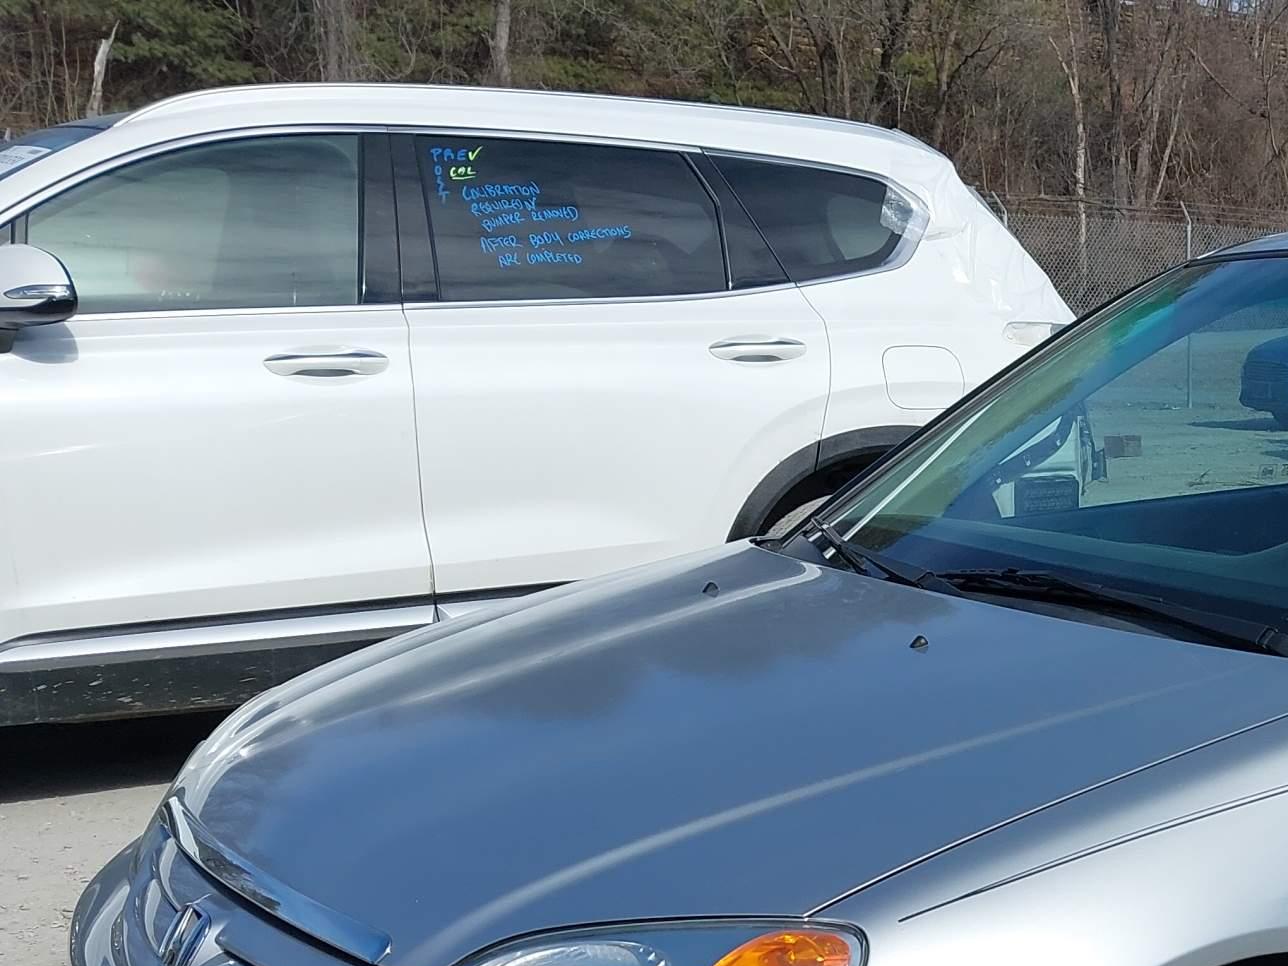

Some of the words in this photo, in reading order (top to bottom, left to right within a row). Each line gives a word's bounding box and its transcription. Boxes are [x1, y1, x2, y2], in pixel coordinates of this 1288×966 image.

[449, 166, 477, 179] CAL
[462, 181, 540, 200] CALIBRATION
[482, 212, 525, 232] BUMPER
[531, 206, 578, 221] REMOVED
[480, 235, 523, 253] AFTER
[528, 231, 564, 248] BODY
[567, 225, 632, 242] CORRECTIONS
[499, 252, 521, 267] ARE
[526, 249, 582, 265] COMPLETED
